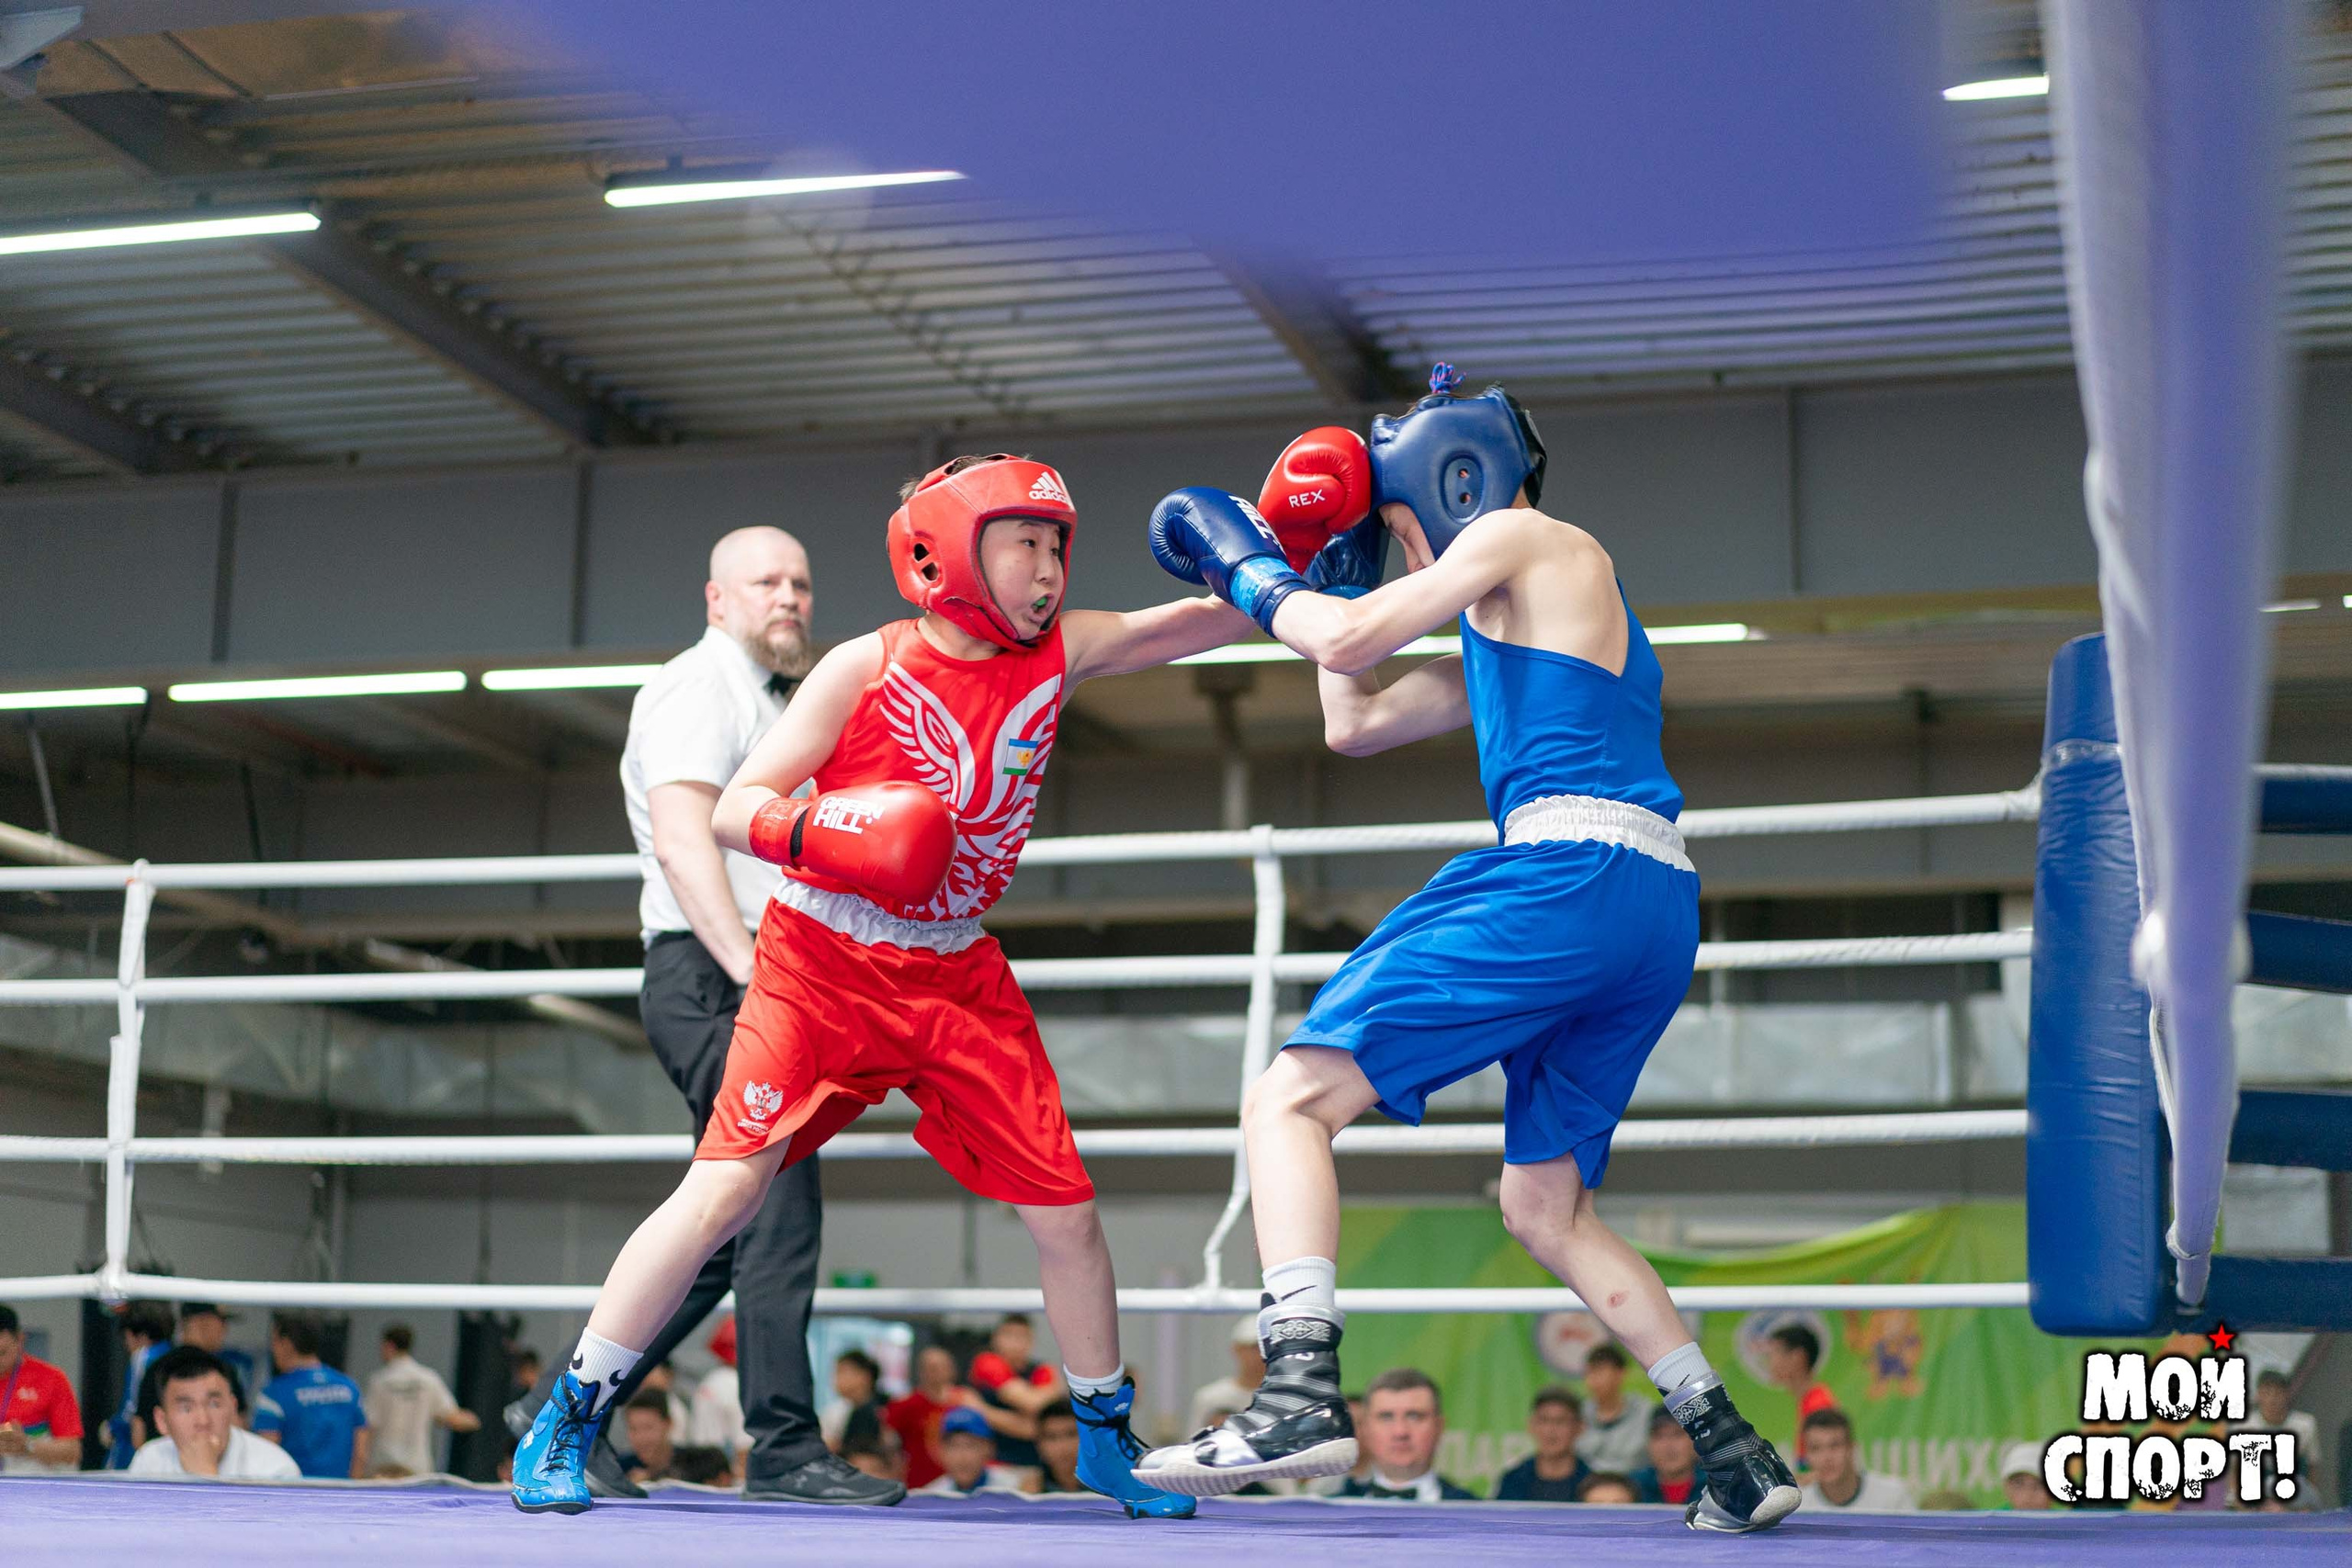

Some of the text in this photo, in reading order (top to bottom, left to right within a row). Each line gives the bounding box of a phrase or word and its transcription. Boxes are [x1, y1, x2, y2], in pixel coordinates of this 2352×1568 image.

[1028, 489, 1069, 504] adida
[1288, 488, 1326, 509] REX
[820, 796, 886, 820] GREEN
[812, 807, 864, 834] HILL
